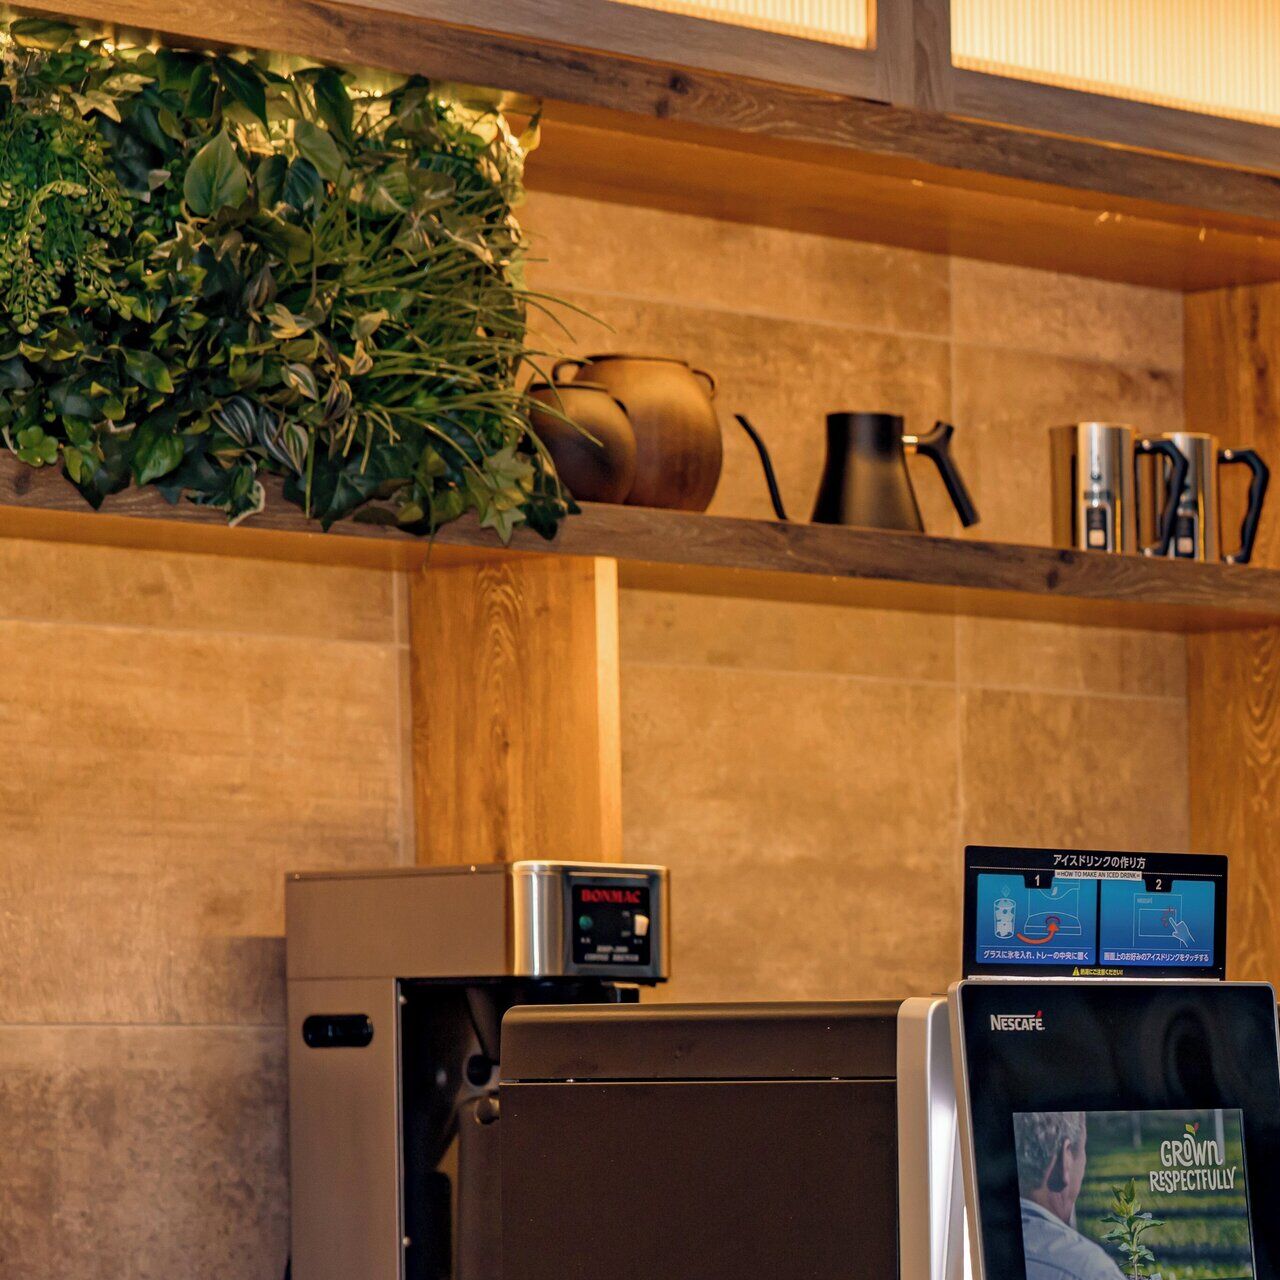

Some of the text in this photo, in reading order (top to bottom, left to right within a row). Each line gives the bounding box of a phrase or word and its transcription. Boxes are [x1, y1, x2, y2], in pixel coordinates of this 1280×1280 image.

[1053, 854, 1146, 869] アイスドリンクの作り方
[1035, 875, 1040, 886] 1
[1155, 879, 1162, 890] 2
[1161, 1133, 1224, 1167] GROWN
[1149, 1166, 1237, 1194] RESPECTFULLY
